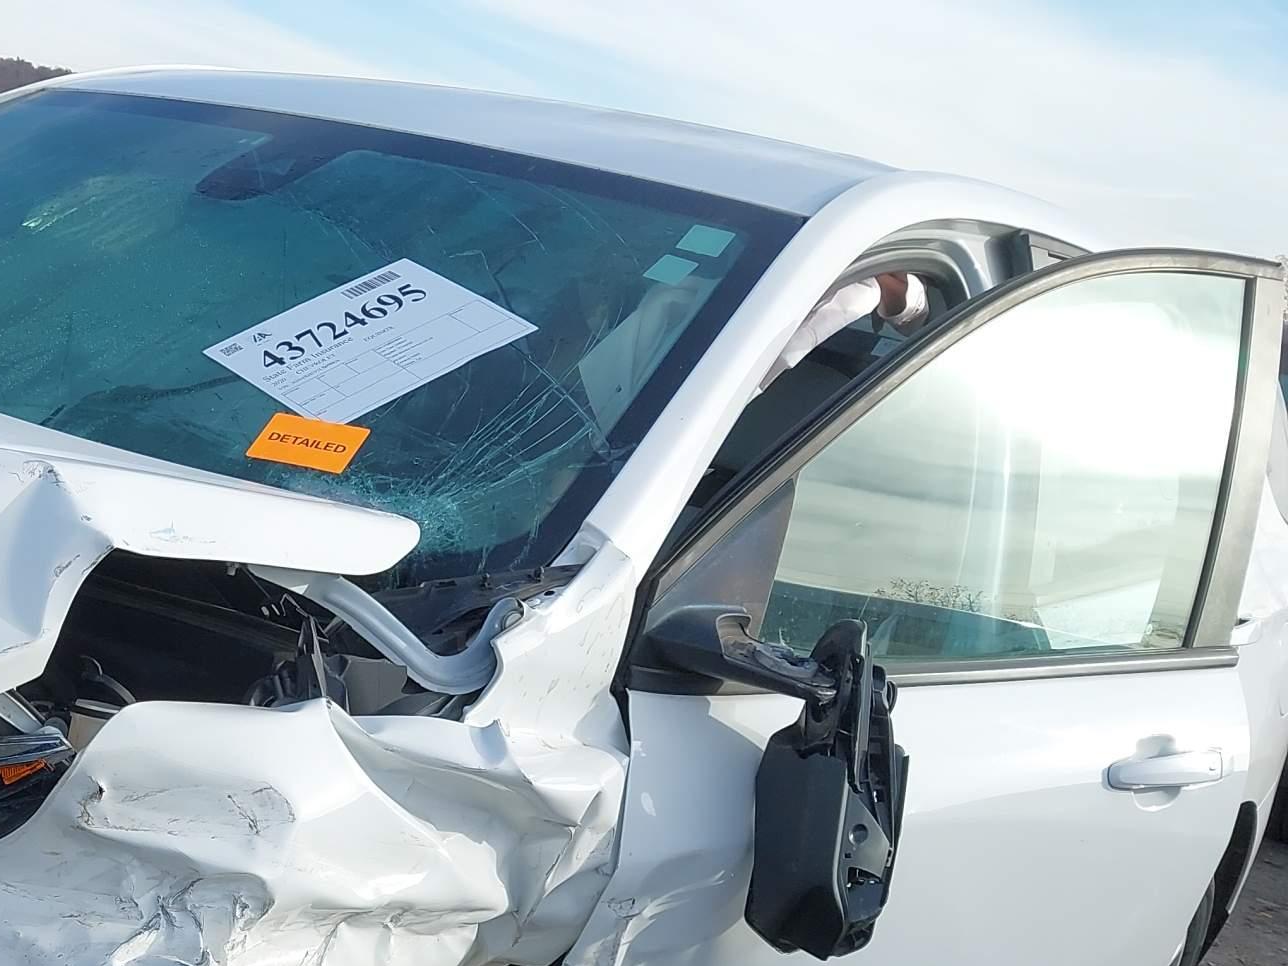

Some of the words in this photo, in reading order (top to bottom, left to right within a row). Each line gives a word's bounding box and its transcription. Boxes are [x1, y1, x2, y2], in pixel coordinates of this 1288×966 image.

[262, 283, 427, 368] 43724695
[262, 369, 287, 382] State
[286, 357, 312, 371] Farm
[310, 336, 353, 358] Insurance
[268, 430, 347, 455] DETAILED
